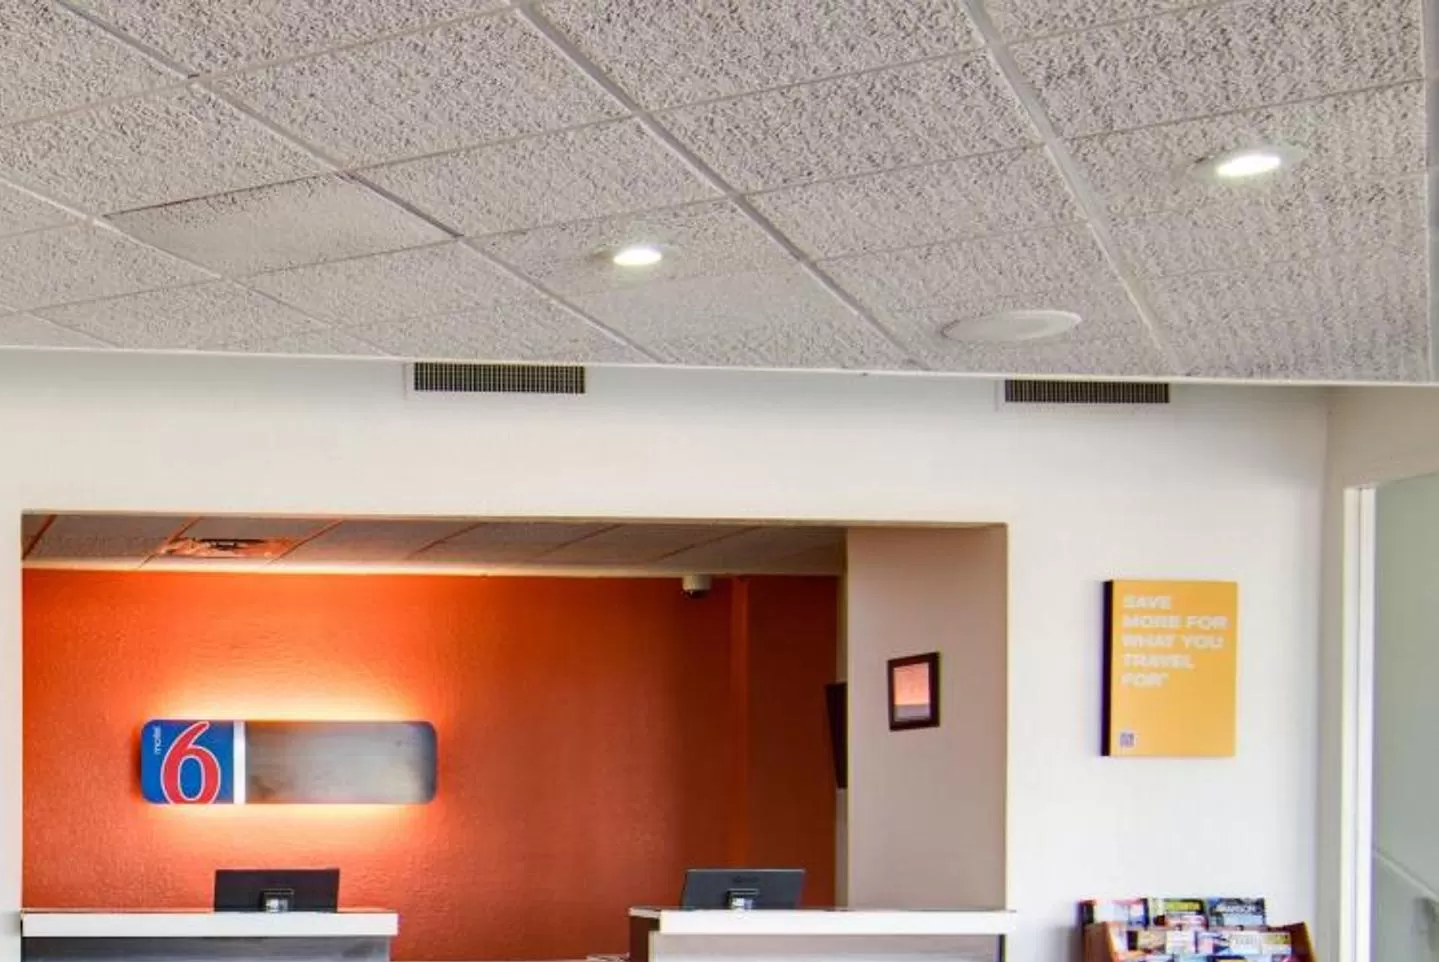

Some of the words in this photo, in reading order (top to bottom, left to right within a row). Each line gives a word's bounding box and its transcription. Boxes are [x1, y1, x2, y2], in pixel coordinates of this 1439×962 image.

[1187, 615, 1229, 630] FOR
[1183, 635, 1224, 648] YOU
[1123, 654, 1194, 668] TRAVEL
[160, 720, 221, 804] 6
